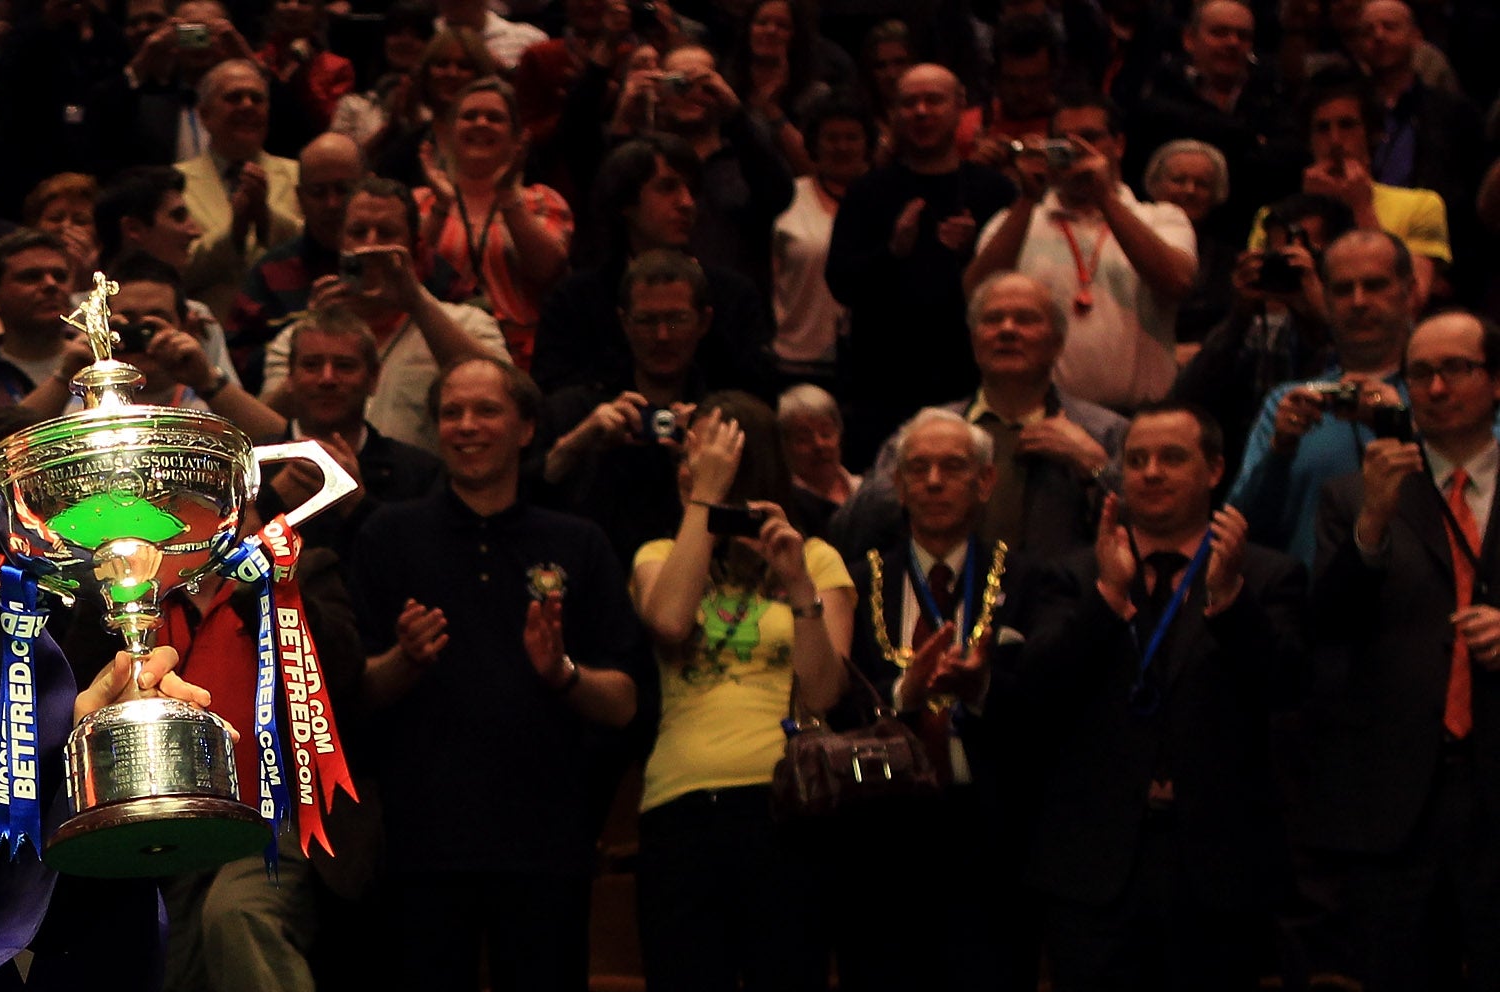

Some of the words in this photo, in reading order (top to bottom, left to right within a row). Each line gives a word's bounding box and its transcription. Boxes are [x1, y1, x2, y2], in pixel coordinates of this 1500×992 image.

[130, 453, 220, 471] ASSOCIATION
[257, 595, 281, 786] BETFRED.COM
[277, 608, 313, 805] BETFRED.COM
